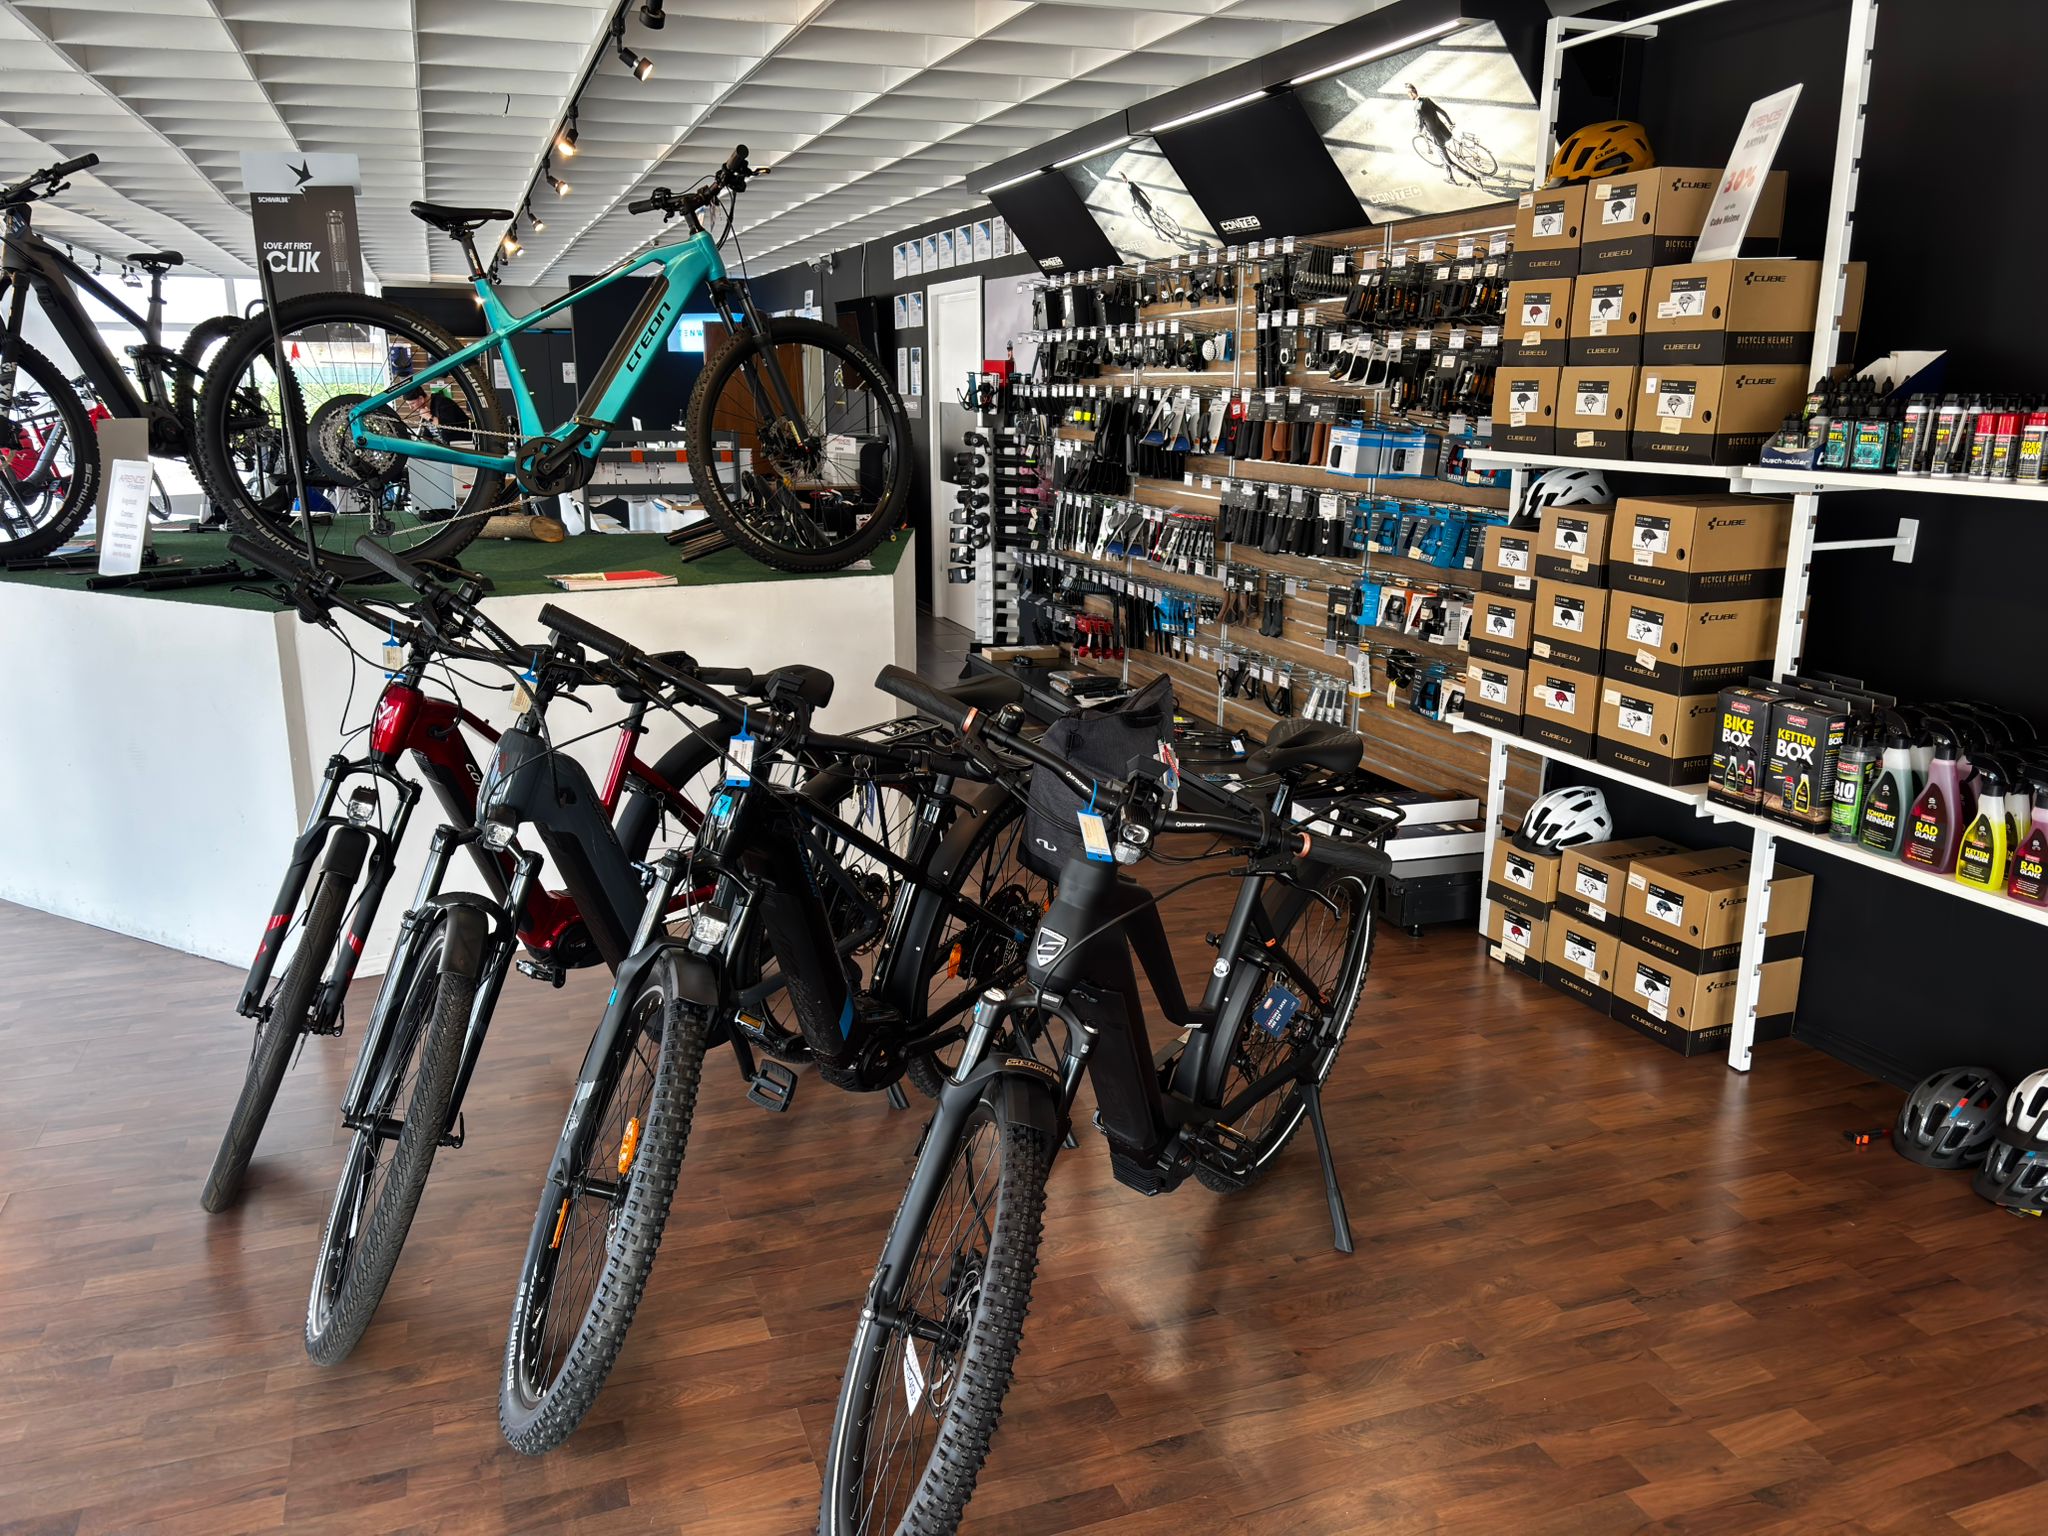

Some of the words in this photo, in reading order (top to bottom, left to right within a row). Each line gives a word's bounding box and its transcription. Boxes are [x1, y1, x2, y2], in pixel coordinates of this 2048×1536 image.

[1595, 146, 1618, 160] CUBE
[1681, 181, 1712, 190] CUBE
[1724, 167, 1757, 193] 30%
[263, 242, 282, 250] LOVE
[283, 242, 293, 250] AT
[293, 242, 312, 250] FIRST
[1665, 240, 1693, 248] BICYCLE
[266, 251, 320, 273] CLIK
[1753, 275, 1787, 283] CUBE
[1737, 336, 1766, 345] BICYCLE
[1766, 335, 1794, 345] HELMET
[845, 344, 900, 413] SCHWALBE
[1745, 378, 1777, 386] CUBE
[1728, 437, 1753, 446] BICYCLE
[56, 463, 94, 534] SCHWALBE
[1716, 519, 1746, 527] CUBE
[1701, 575, 1726, 584] BICYCLE
[1727, 573, 1752, 583] HELMET
[1709, 613, 1737, 621] CUBE
[483, 626, 515, 652] CONWAY
[1693, 668, 1718, 678] BICYCLE
[1719, 666, 1744, 676] HELMET
[1723, 714, 1755, 735] BIKE
[1722, 729, 1752, 748] BOX
[1777, 728, 1816, 748] KETTEN
[1828, 737, 1843, 746] BOX
[1776, 739, 1815, 766] BOX
[1683, 759, 1708, 768] BICYCLE
[1834, 780, 1855, 799] BIO
[1867, 808, 1896, 823] KOMPLETT
[1866, 816, 1895, 829] REINIGER
[1915, 821, 1938, 837] RAD
[1914, 831, 1937, 842] GLANZ
[1965, 847, 1989, 860] KETTEN
[1965, 853, 1988, 864] REINIGER
[2020, 861, 2042, 875] RAD
[2019, 869, 2041, 880] GLANZ
[1713, 948, 1736, 957] BICYCLE
[1700, 1029, 1721, 1039] BICYCLE
[507, 1281, 527, 1391] SCHWALBE
